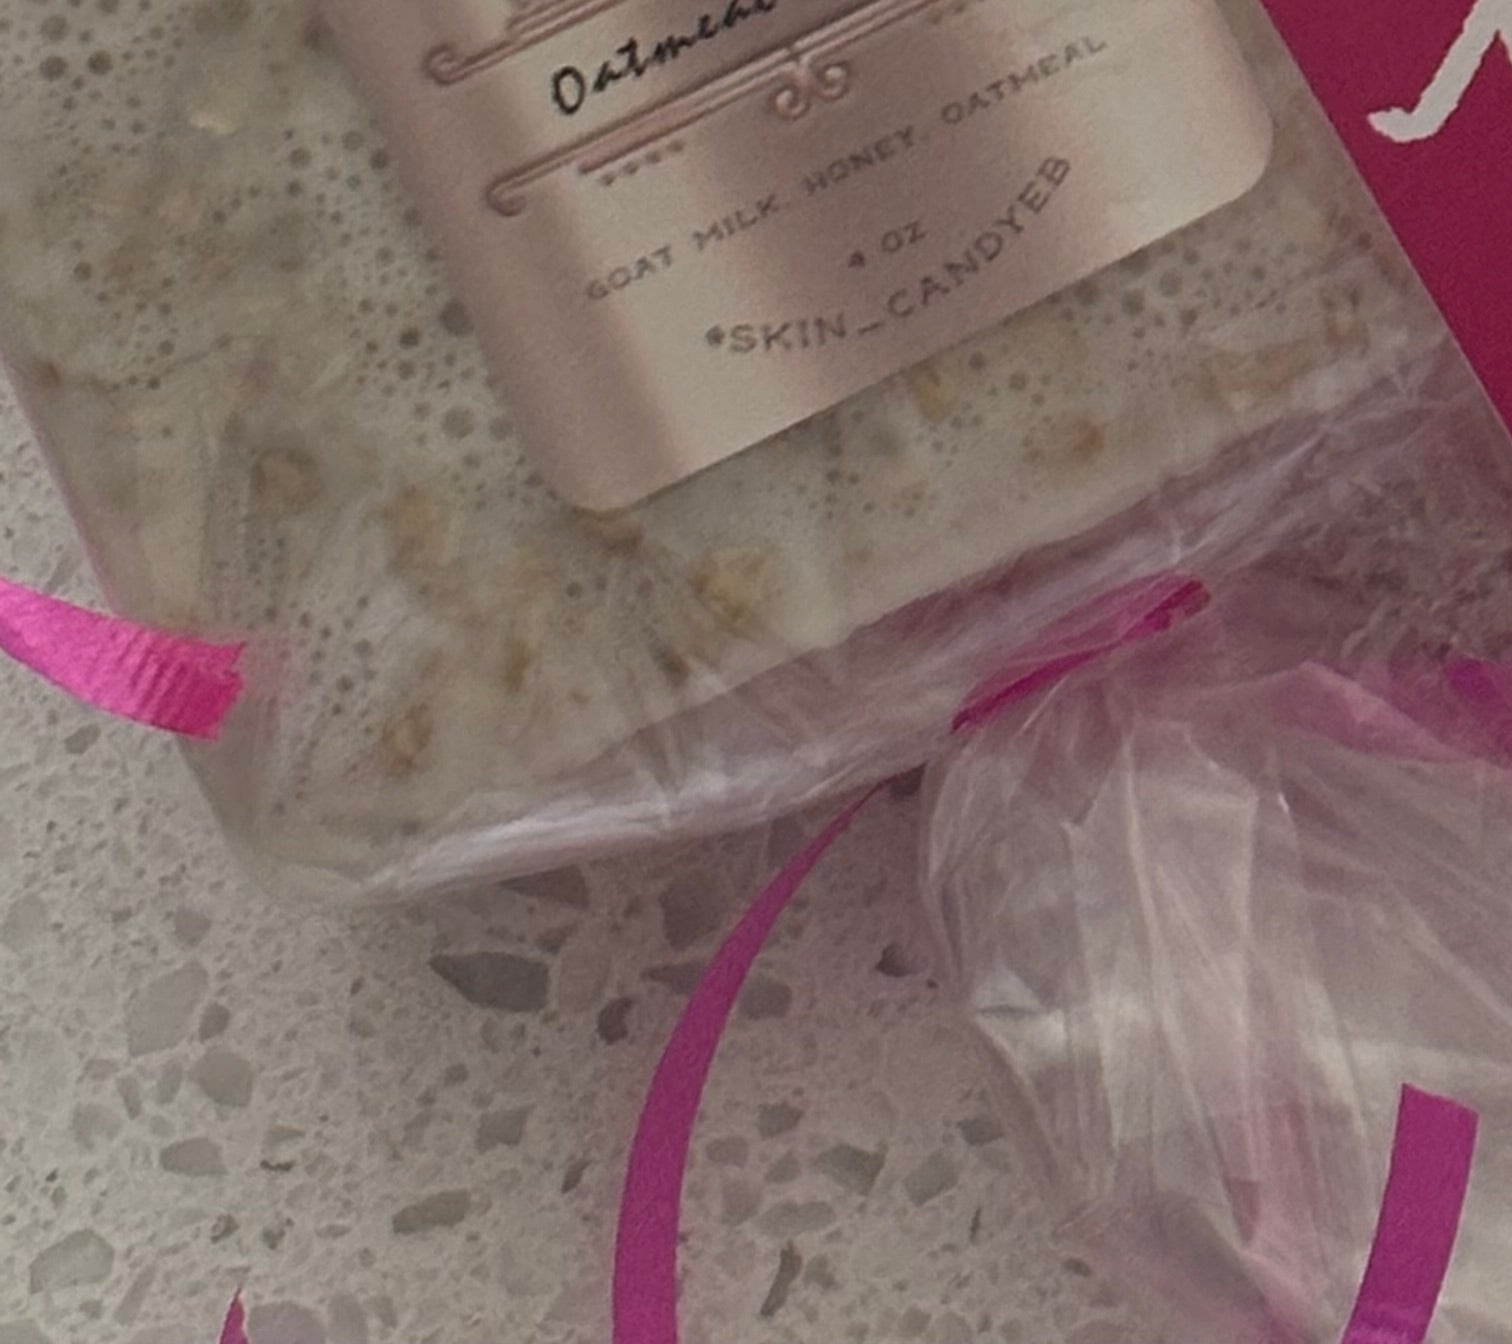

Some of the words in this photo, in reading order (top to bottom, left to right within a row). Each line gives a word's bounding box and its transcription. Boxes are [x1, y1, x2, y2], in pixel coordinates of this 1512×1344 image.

[584, 243, 675, 302] GOAT
[940, 34, 1108, 126] OATMEAL
[880, 219, 926, 255] OZ
